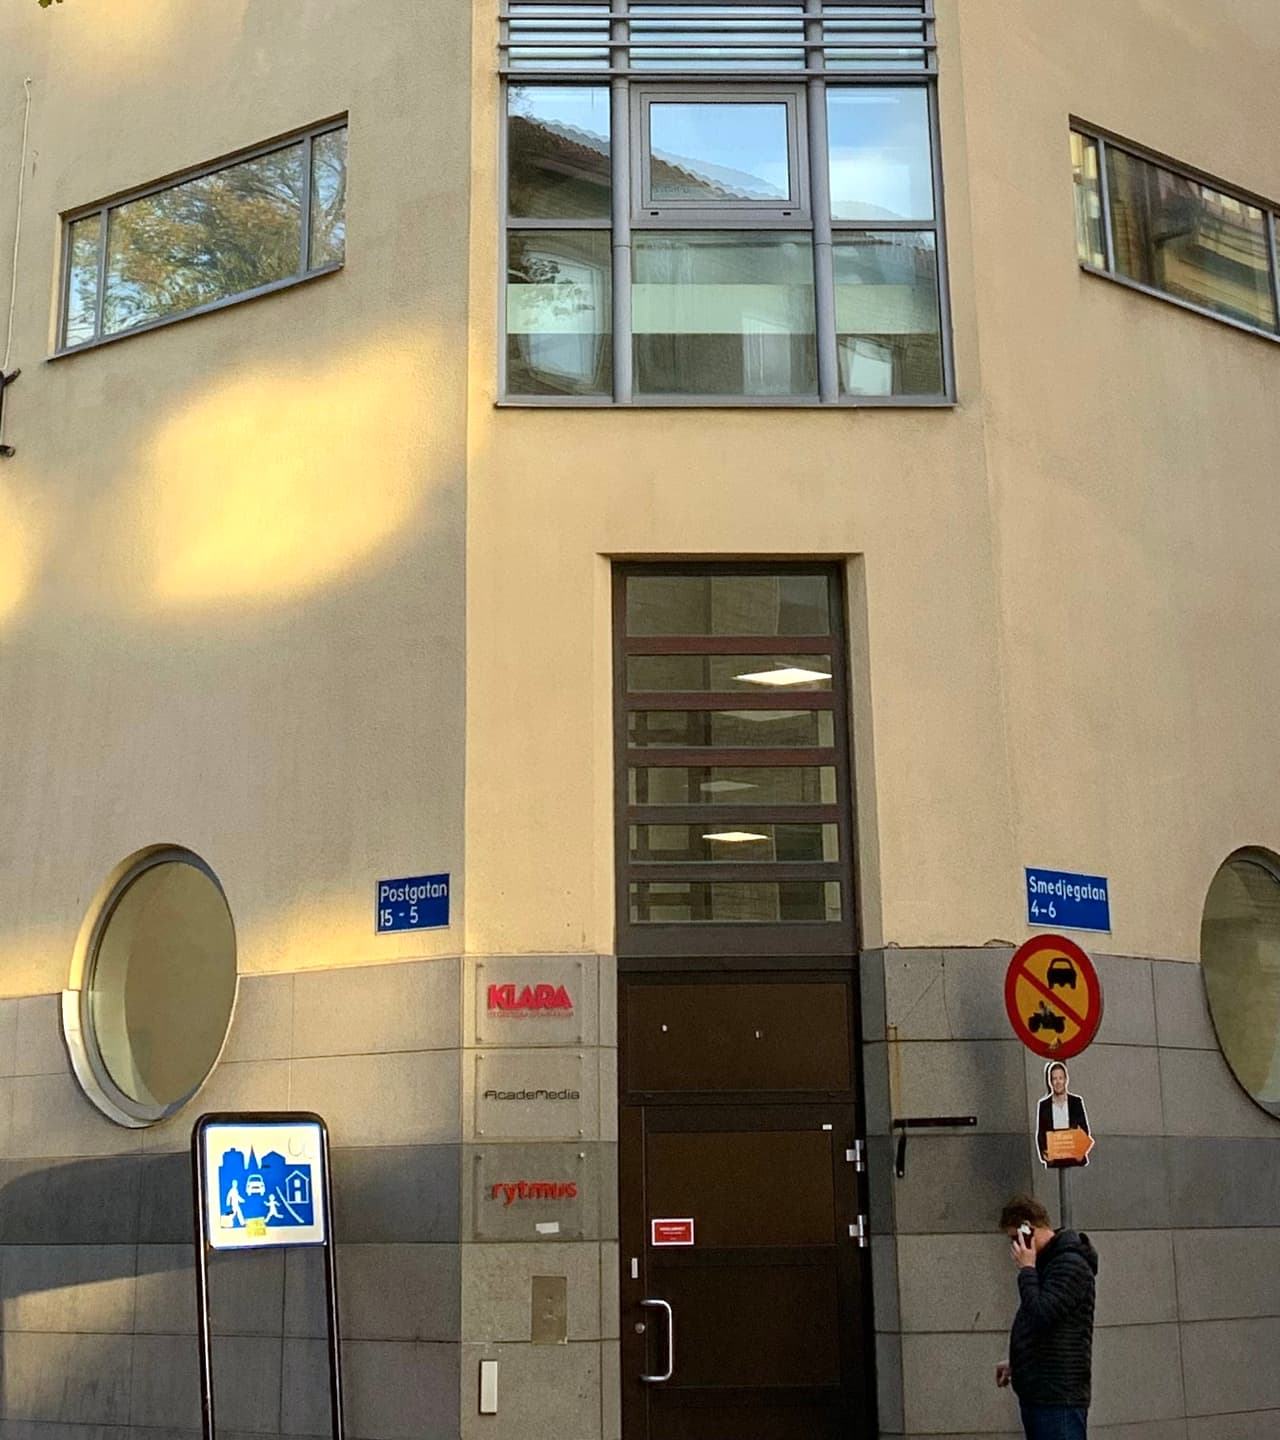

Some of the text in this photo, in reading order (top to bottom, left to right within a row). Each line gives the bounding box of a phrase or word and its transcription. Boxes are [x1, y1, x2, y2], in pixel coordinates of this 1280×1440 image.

[380, 881, 447, 904] Postgatan
[1029, 875, 1106, 902] Smedjegatan
[380, 908, 393, 927] 15
[409, 906, 418, 924] 5
[1030, 900, 1057, 918] 4-6
[487, 983, 573, 1009] KLARA
[484, 1089, 580, 1101] AcadeMedia
[491, 1181, 577, 1208] rytmus
